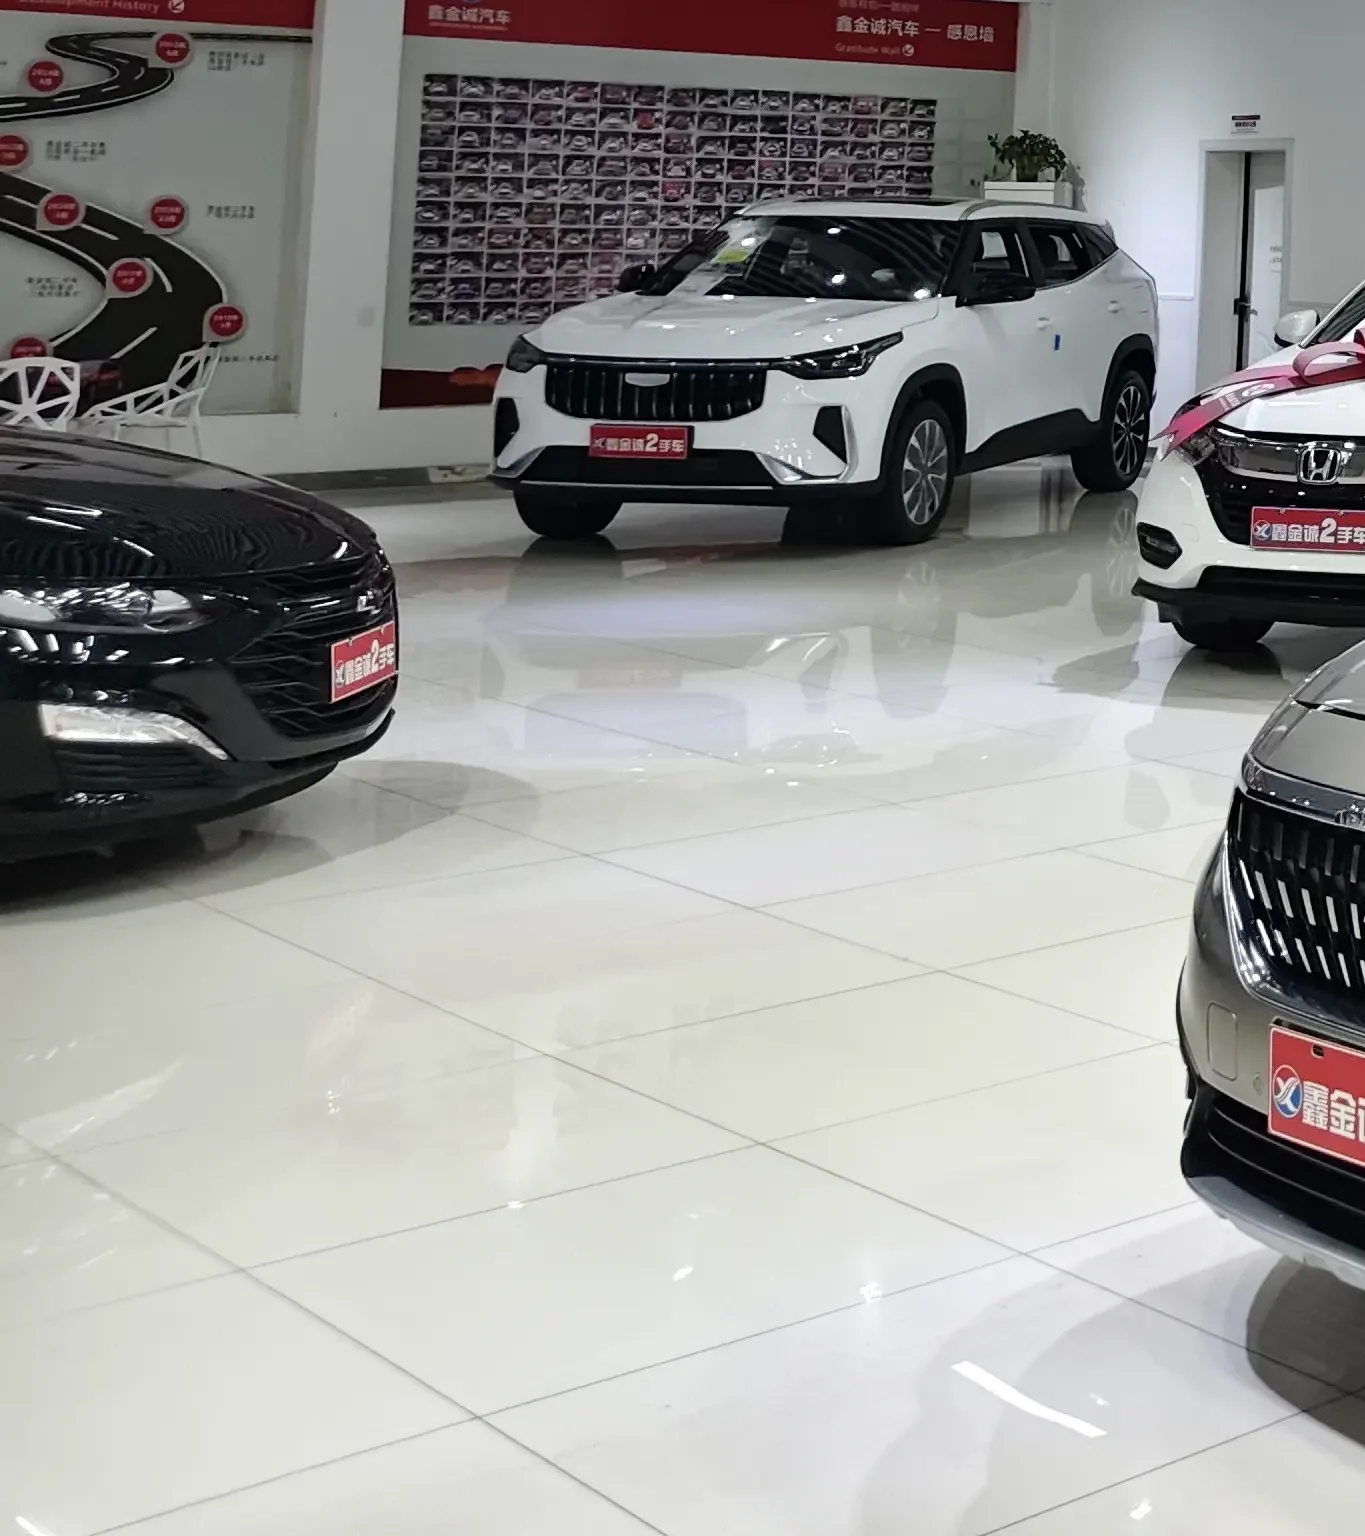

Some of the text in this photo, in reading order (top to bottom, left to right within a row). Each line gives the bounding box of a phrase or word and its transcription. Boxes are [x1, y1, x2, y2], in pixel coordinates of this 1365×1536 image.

[836, 14, 920, 38] 鑫金诚汽车
